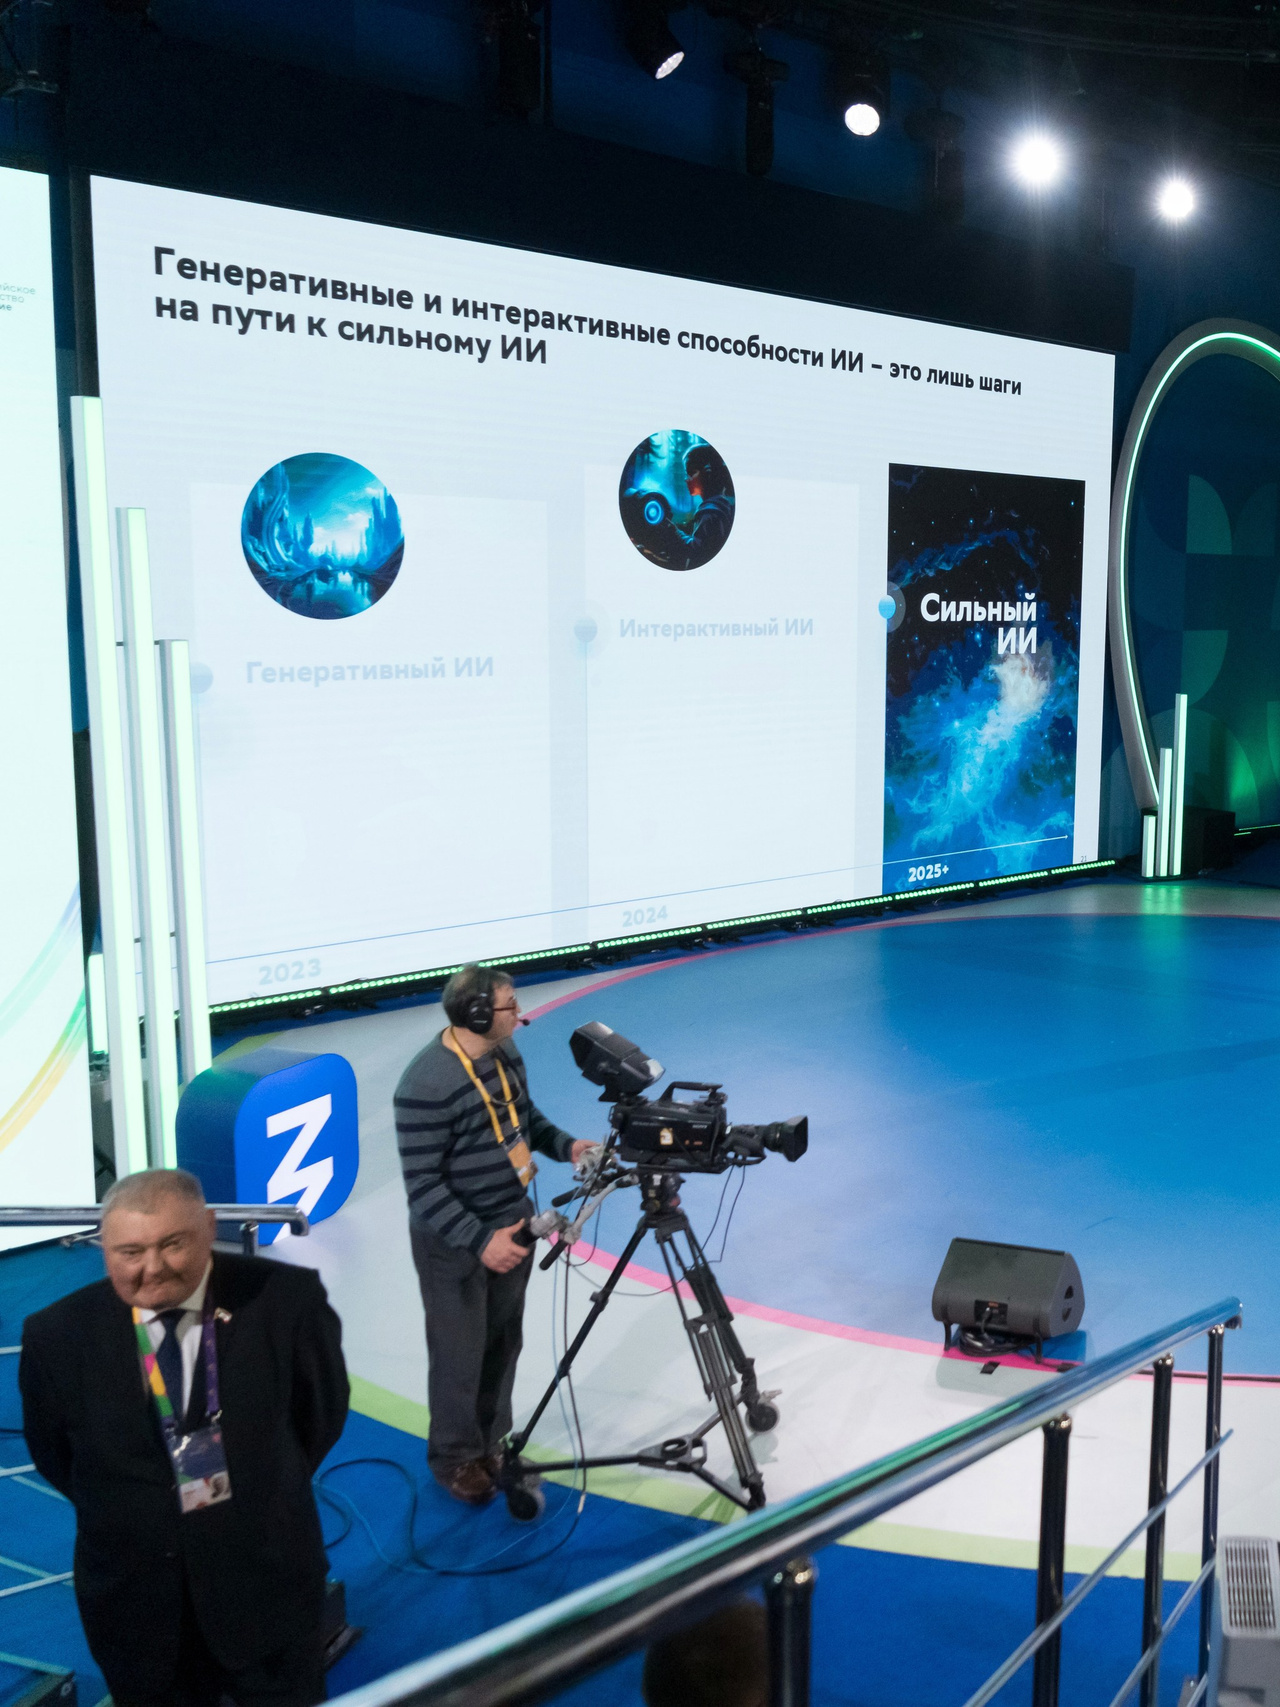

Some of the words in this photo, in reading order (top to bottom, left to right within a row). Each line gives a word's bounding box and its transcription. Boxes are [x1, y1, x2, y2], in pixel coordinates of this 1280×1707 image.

[154, 246, 413, 310] Генеративные
[424, 293, 441, 314] и
[452, 297, 670, 346] интерактивные
[677, 330, 824, 368] способности
[831, 348, 864, 373] ИИ
[890, 362, 921, 381] это
[926, 368, 974, 388] лишь
[979, 375, 1022, 395] шаги
[155, 296, 199, 322] на
[212, 303, 295, 335] пути
[307, 315, 328, 338] к
[337, 320, 492, 364] сильному
[501, 334, 547, 365] ИИ
[920, 592, 1037, 622] Сильный
[619, 617, 779, 641] Интерактивный
[785, 618, 814, 636] ИИ
[997, 627, 1037, 655] ИИ
[246, 656, 446, 688] Генеративный
[454, 656, 494, 677] ИИ
[908, 863, 950, 883] 2025+
[622, 905, 668, 928] 2024
[259, 958, 321, 986] 2023
